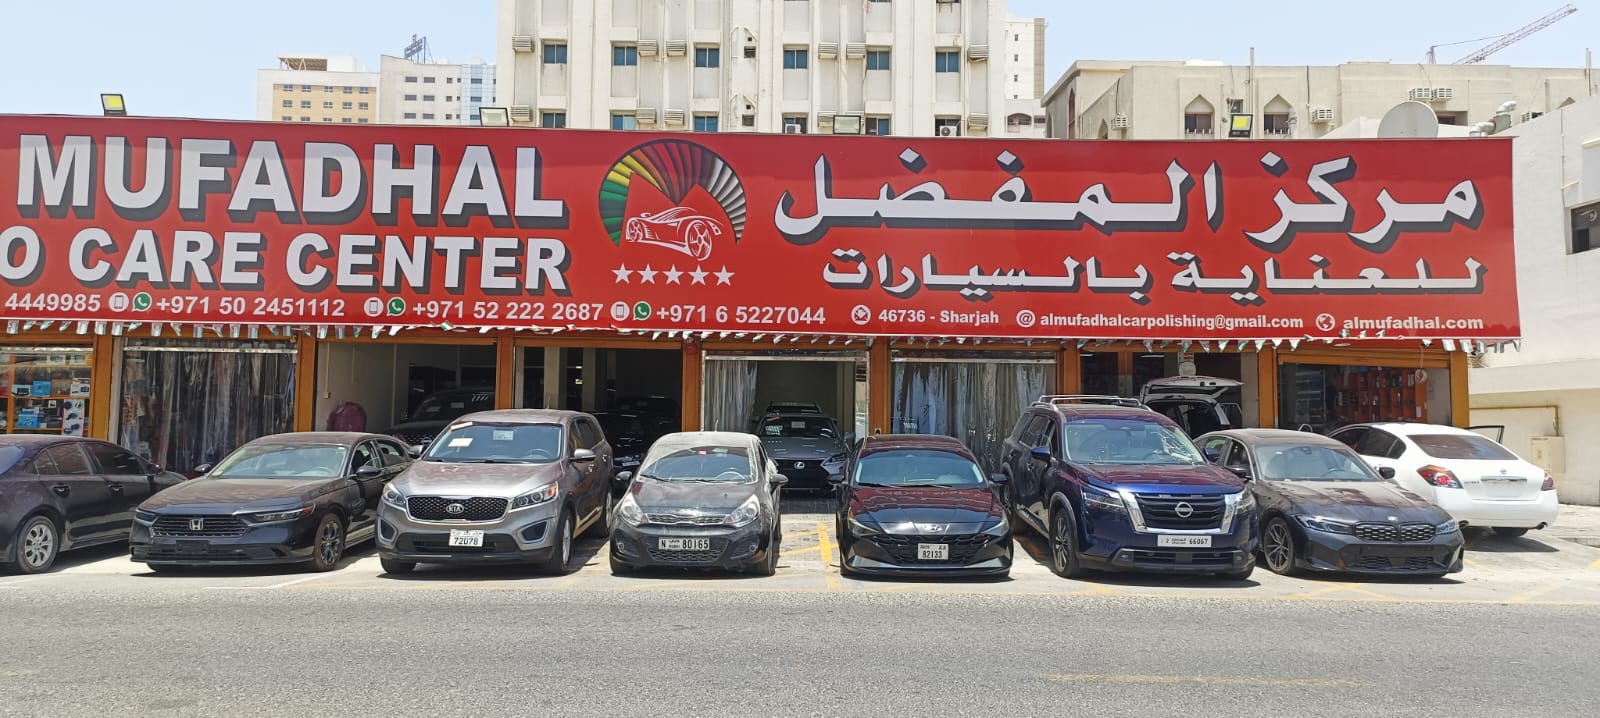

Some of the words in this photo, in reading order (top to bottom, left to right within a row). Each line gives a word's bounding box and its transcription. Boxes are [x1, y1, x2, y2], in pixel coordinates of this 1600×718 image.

[17, 134, 566, 222] MUFADHAL
[773, 146, 1220, 238] المفضل
[1243, 150, 1480, 246] مركز
[68, 227, 264, 286] CARE
[286, 232, 569, 292] CENTER
[822, 248, 1149, 301] بالسيارات
[1165, 250, 1483, 302] للعناية
[5, 293, 101, 312] 4449985
[157, 295, 210, 315] +971
[219, 297, 246, 315] 50
[253, 297, 346, 317] 2451112
[412, 300, 465, 318] +971
[473, 301, 499, 319] 52
[506, 301, 545, 320] 222
[551, 302, 604, 321] 2687
[656, 304, 706, 322] +971
[715, 305, 728, 323] 6
[735, 306, 826, 324] 5227044
[878, 309, 926, 323] 46736
[940, 310, 999, 327] Sharjah
[1039, 312, 1304, 330] almufadhalcarpolishing@gmail.com
[1343, 316, 1484, 331] almufadhal.com
[682, 539, 709, 549] 80165
